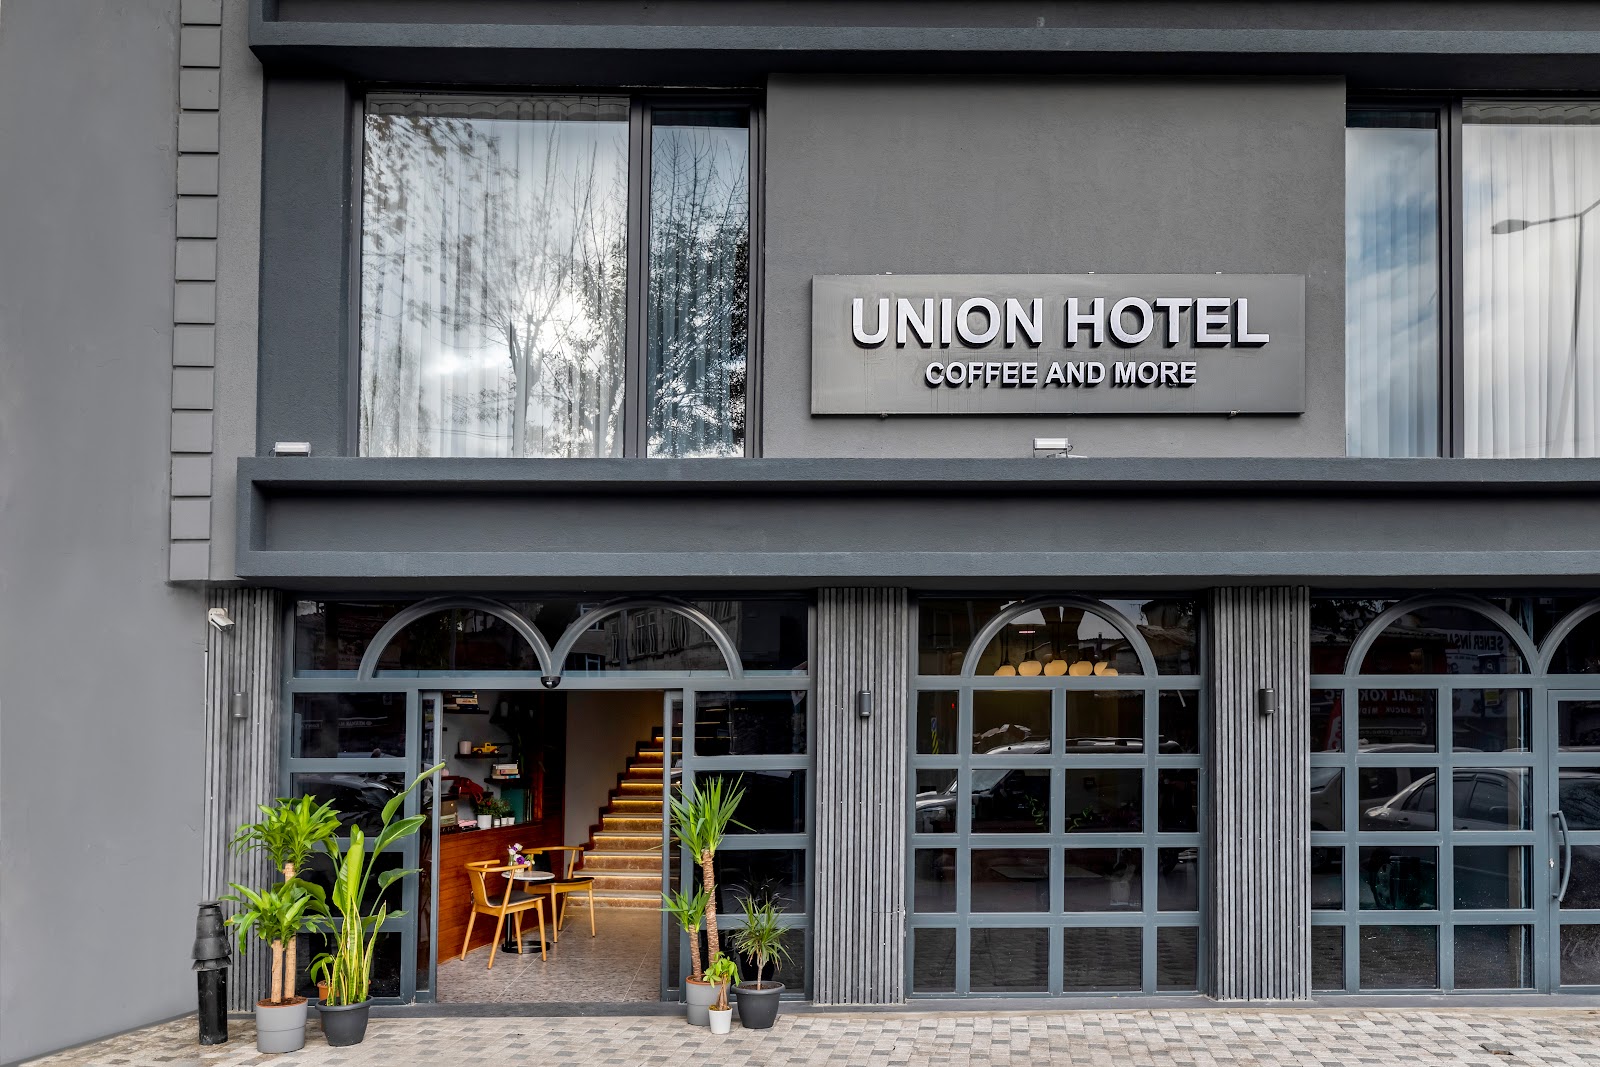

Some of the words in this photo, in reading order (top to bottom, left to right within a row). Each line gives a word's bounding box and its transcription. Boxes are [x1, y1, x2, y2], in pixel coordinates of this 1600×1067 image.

[851, 296, 1044, 347] UNION
[1065, 296, 1270, 347] HOTEL
[924, 361, 1039, 387] COFFEE
[1045, 361, 1107, 387] AND
[1114, 361, 1197, 387] MORE
